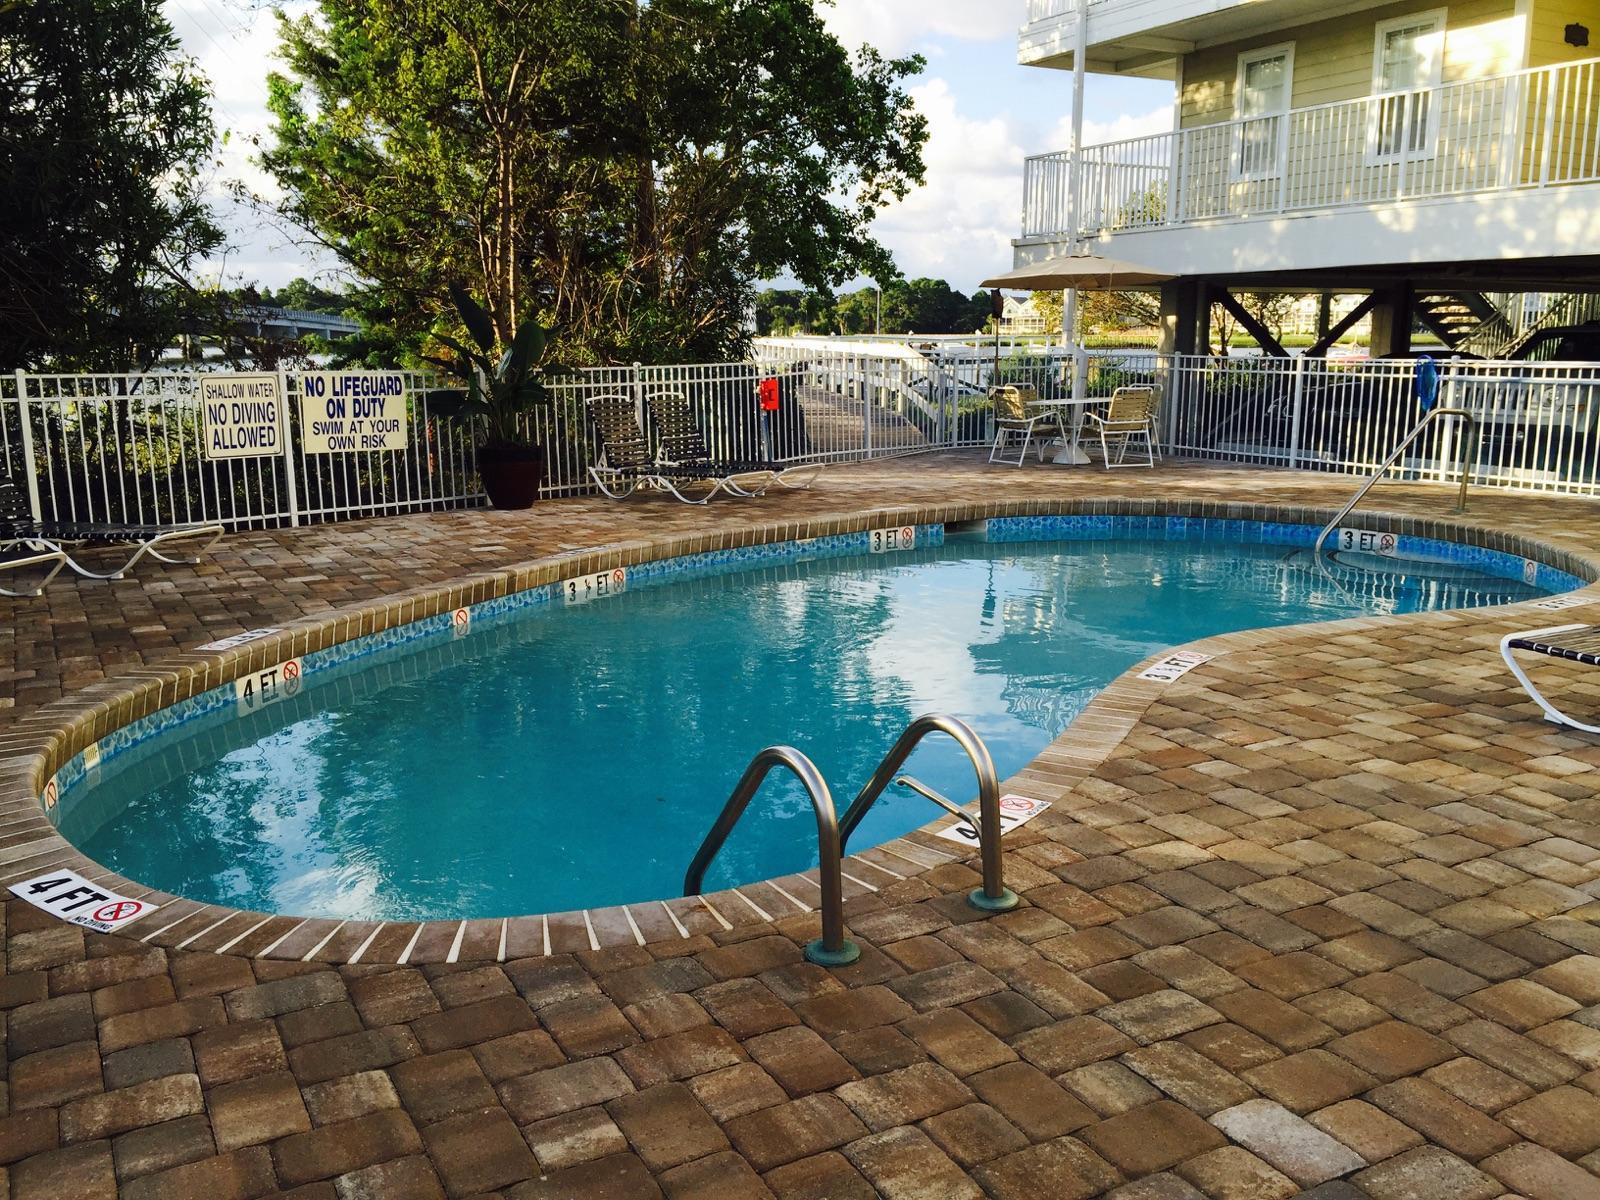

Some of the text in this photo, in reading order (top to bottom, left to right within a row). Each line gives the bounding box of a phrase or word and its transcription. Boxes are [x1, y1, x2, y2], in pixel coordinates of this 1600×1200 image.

[206, 383, 274, 400] SHALLOW WATER
[305, 376, 402, 397] NO LIFEGUARD
[208, 401, 276, 425] NO DIVING
[326, 398, 386, 419] ON DUTY
[312, 419, 400, 435] SWIM AT YOUR
[213, 426, 276, 450] ALLOWED
[328, 434, 387, 450] OWN RISK
[243, 669, 278, 698] 4 FT
[28, 877, 110, 912] 4 FT
